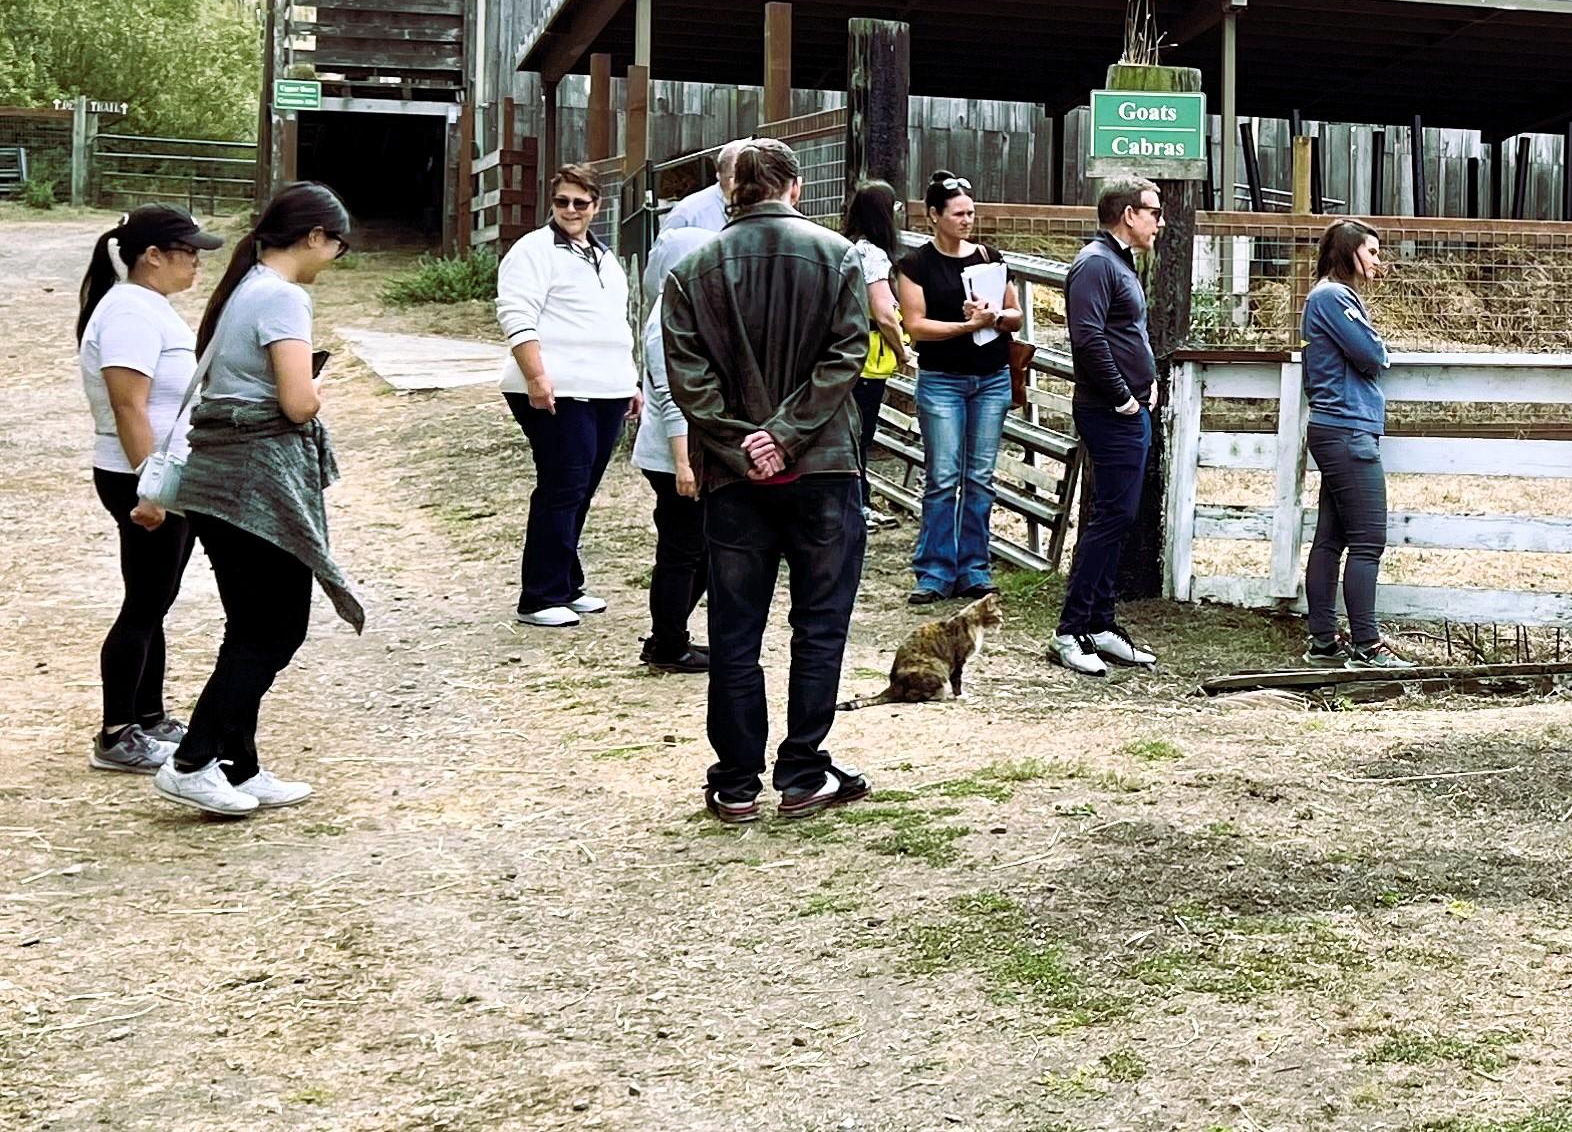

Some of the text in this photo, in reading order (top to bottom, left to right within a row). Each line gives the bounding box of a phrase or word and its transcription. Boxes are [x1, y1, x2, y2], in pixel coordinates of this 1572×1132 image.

[91, 101, 120, 113] TRAIL
[1118, 101, 1177, 121] Goats
[1111, 136, 1185, 156] Cabras
